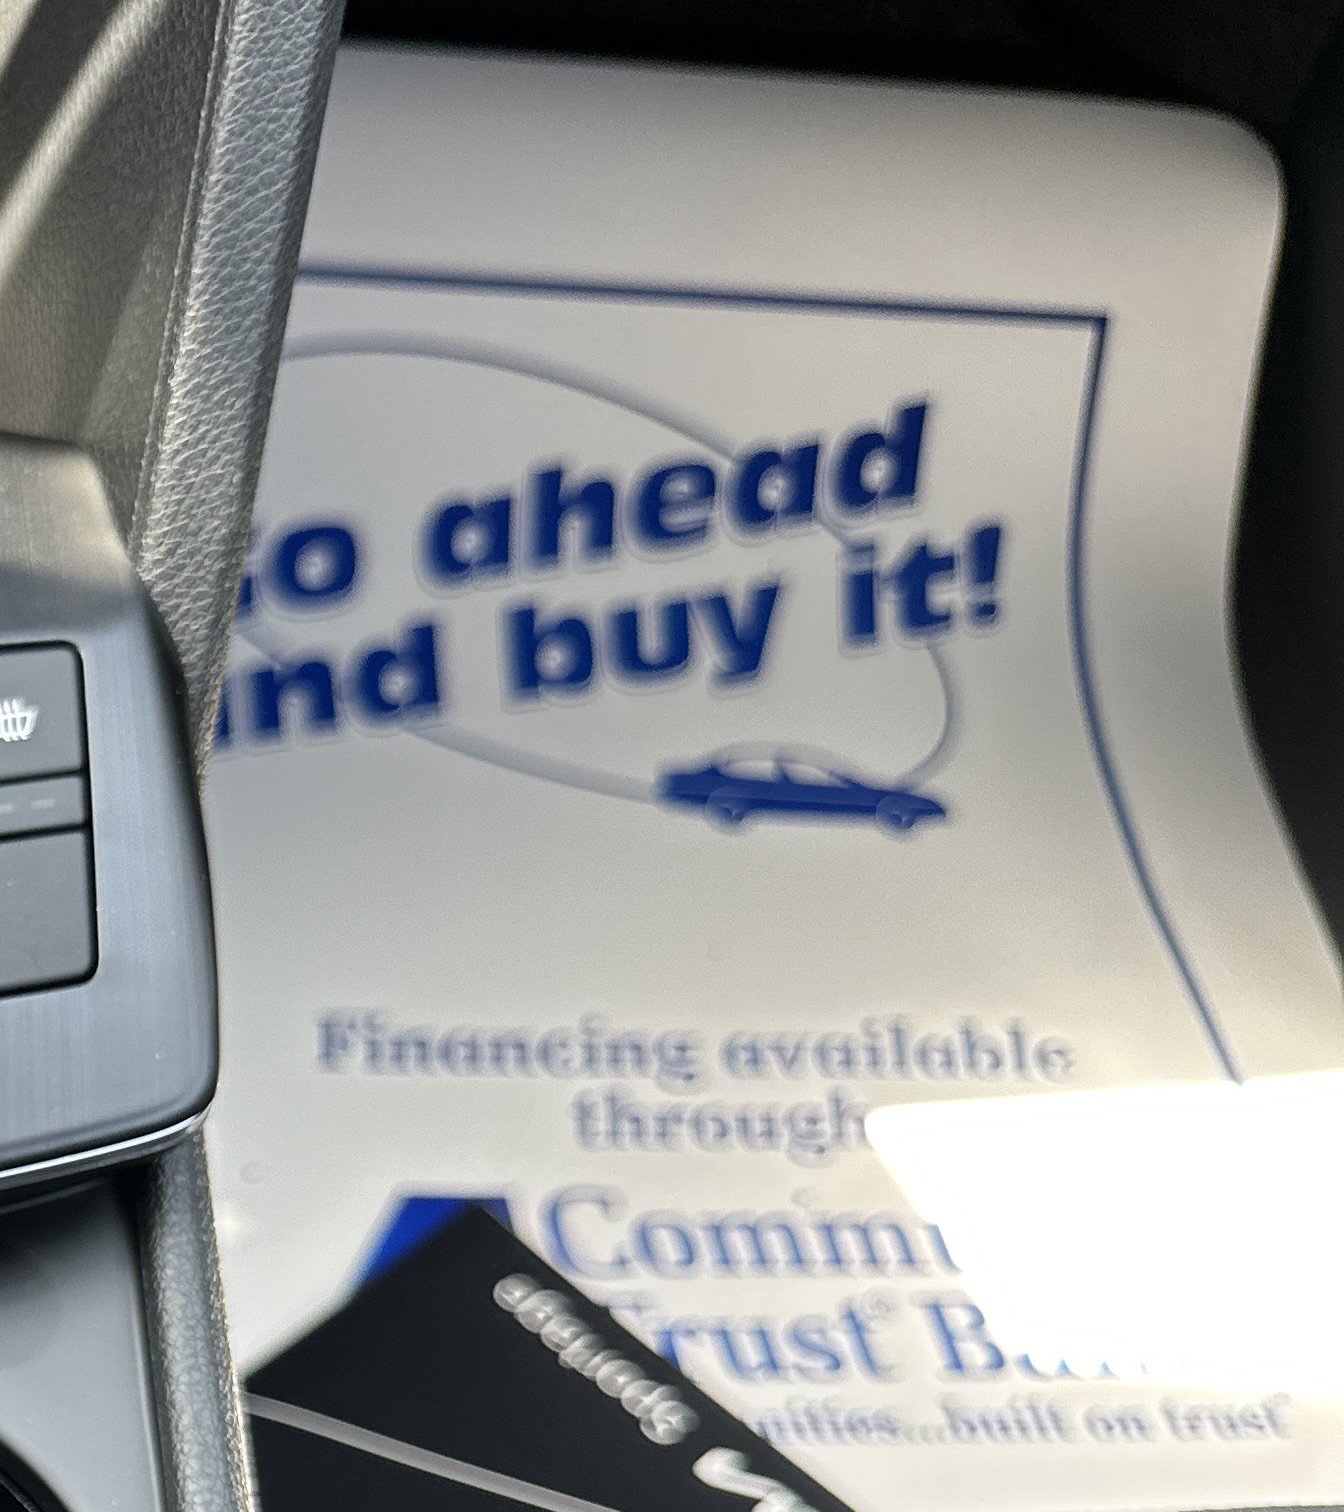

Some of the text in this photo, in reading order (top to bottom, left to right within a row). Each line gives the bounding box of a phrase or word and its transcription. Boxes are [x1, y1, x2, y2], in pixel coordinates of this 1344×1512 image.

[237, 403, 928, 618] o ahead
[215, 523, 1002, 745] nd buy it!
[315, 1010, 1077, 1085] Financing available
[574, 1090, 868, 1165] through
[1085, 1402, 1158, 1444] on
